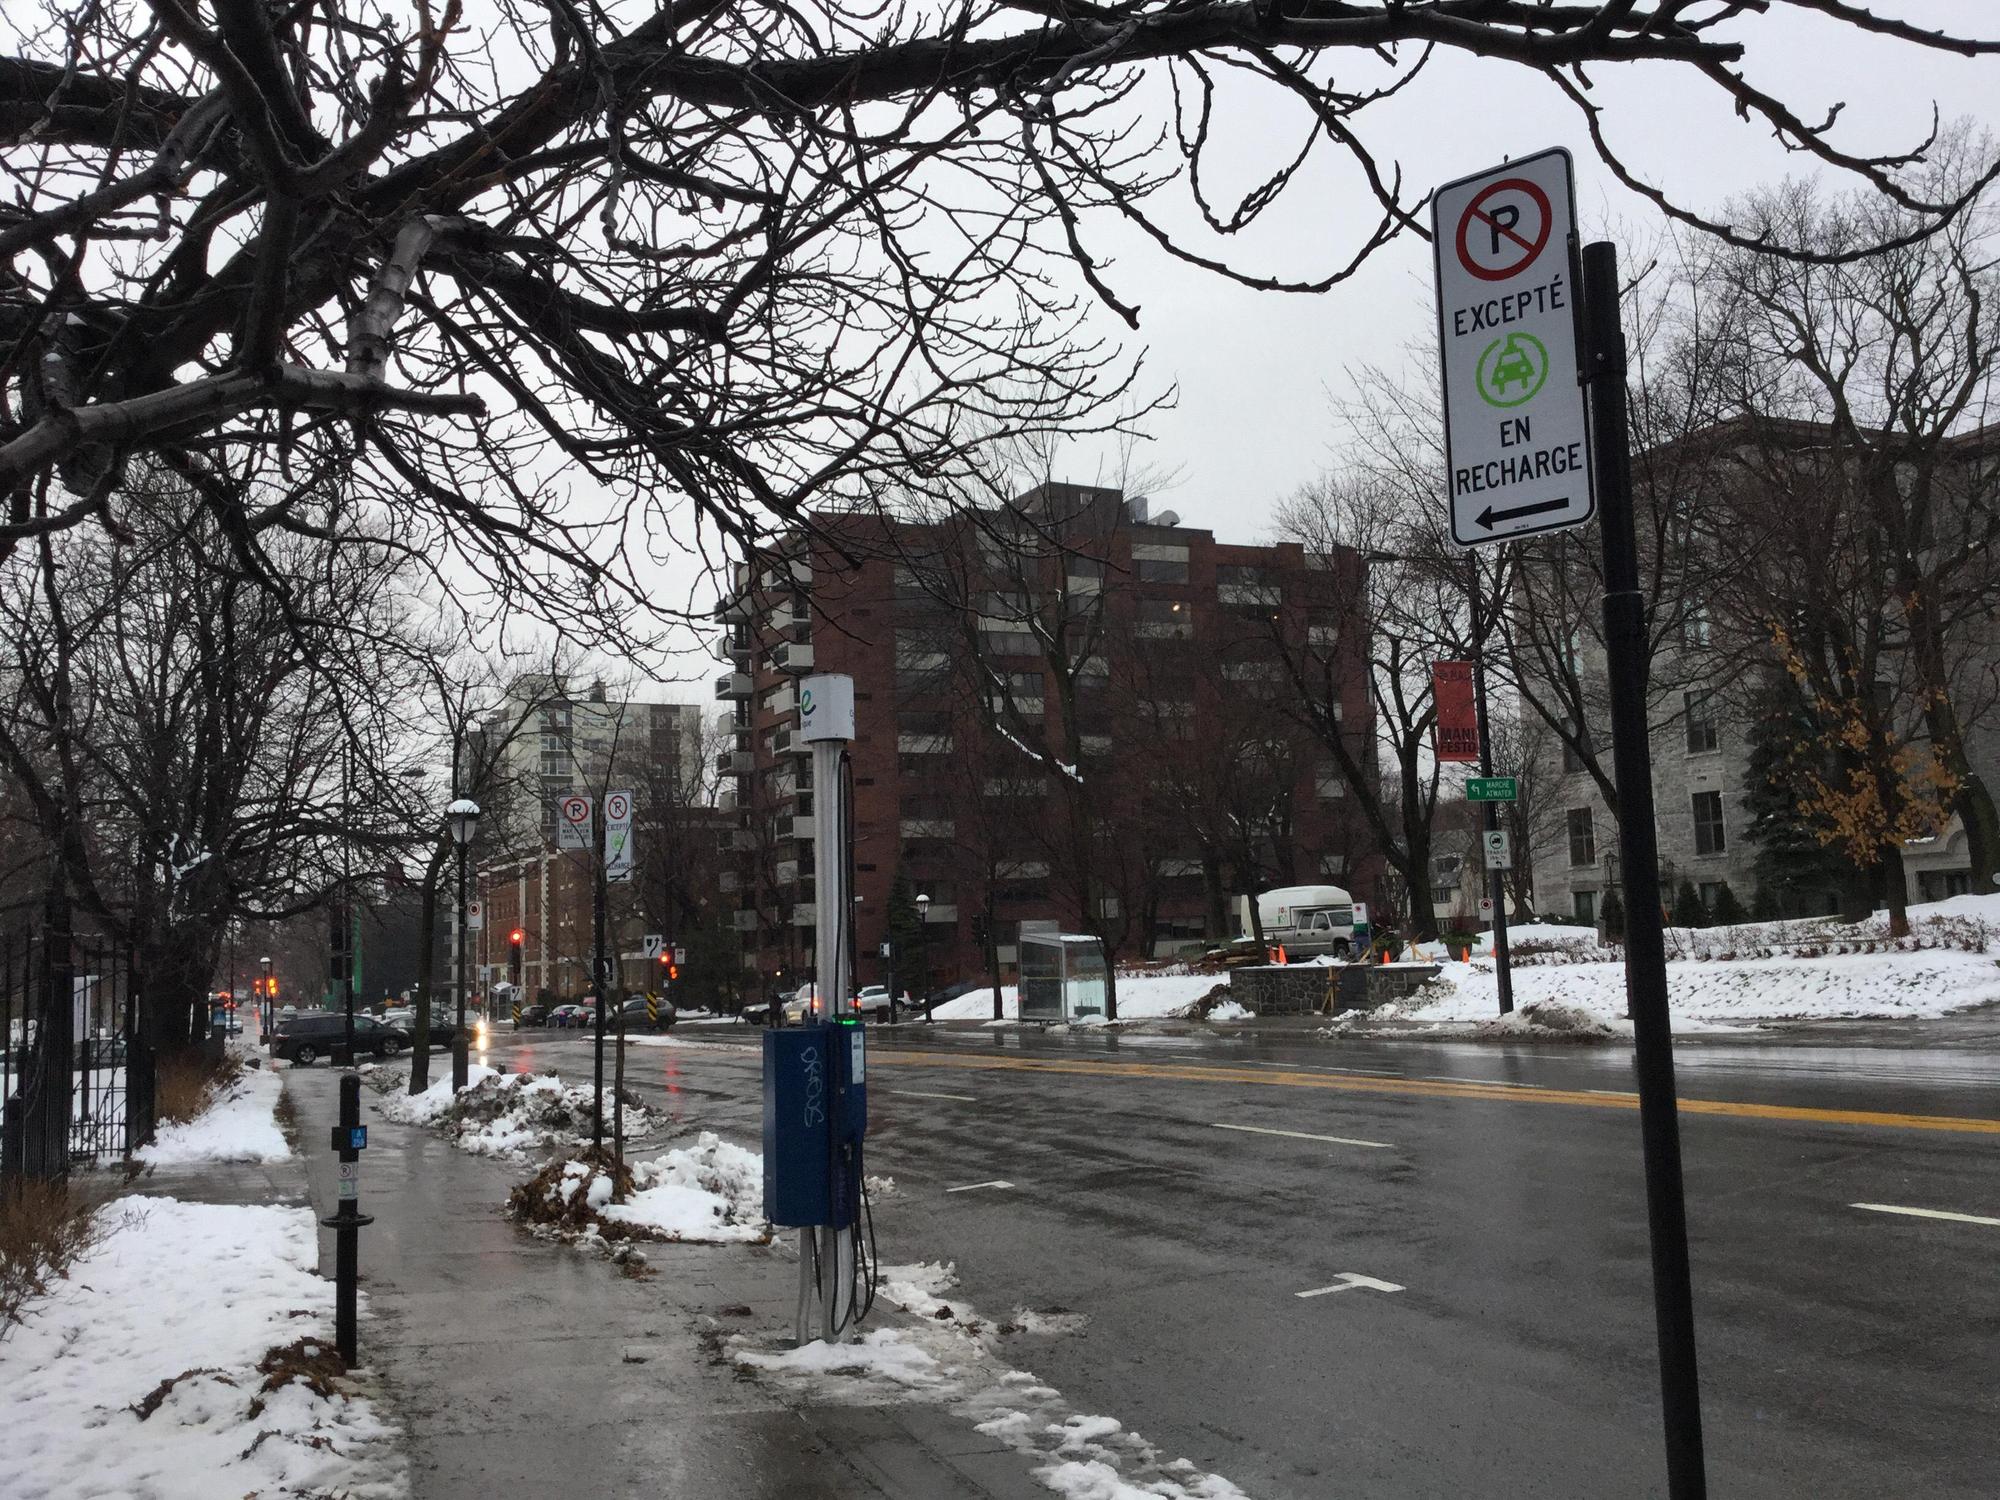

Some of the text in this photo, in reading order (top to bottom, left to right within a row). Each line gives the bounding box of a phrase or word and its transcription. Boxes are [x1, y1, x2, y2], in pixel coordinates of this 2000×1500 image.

[1489, 204, 1520, 255] P
[1454, 274, 1565, 337] EXCEPTÉ
[1500, 416, 1532, 448] EN
[1455, 443, 1583, 496] RECHARGE
[1440, 728, 1476, 741] MANI
[1440, 742, 1477, 753] FESTO
[1486, 789, 1513, 798] ATWATER
[572, 804, 581, 816] P
[615, 802, 621, 813] P
